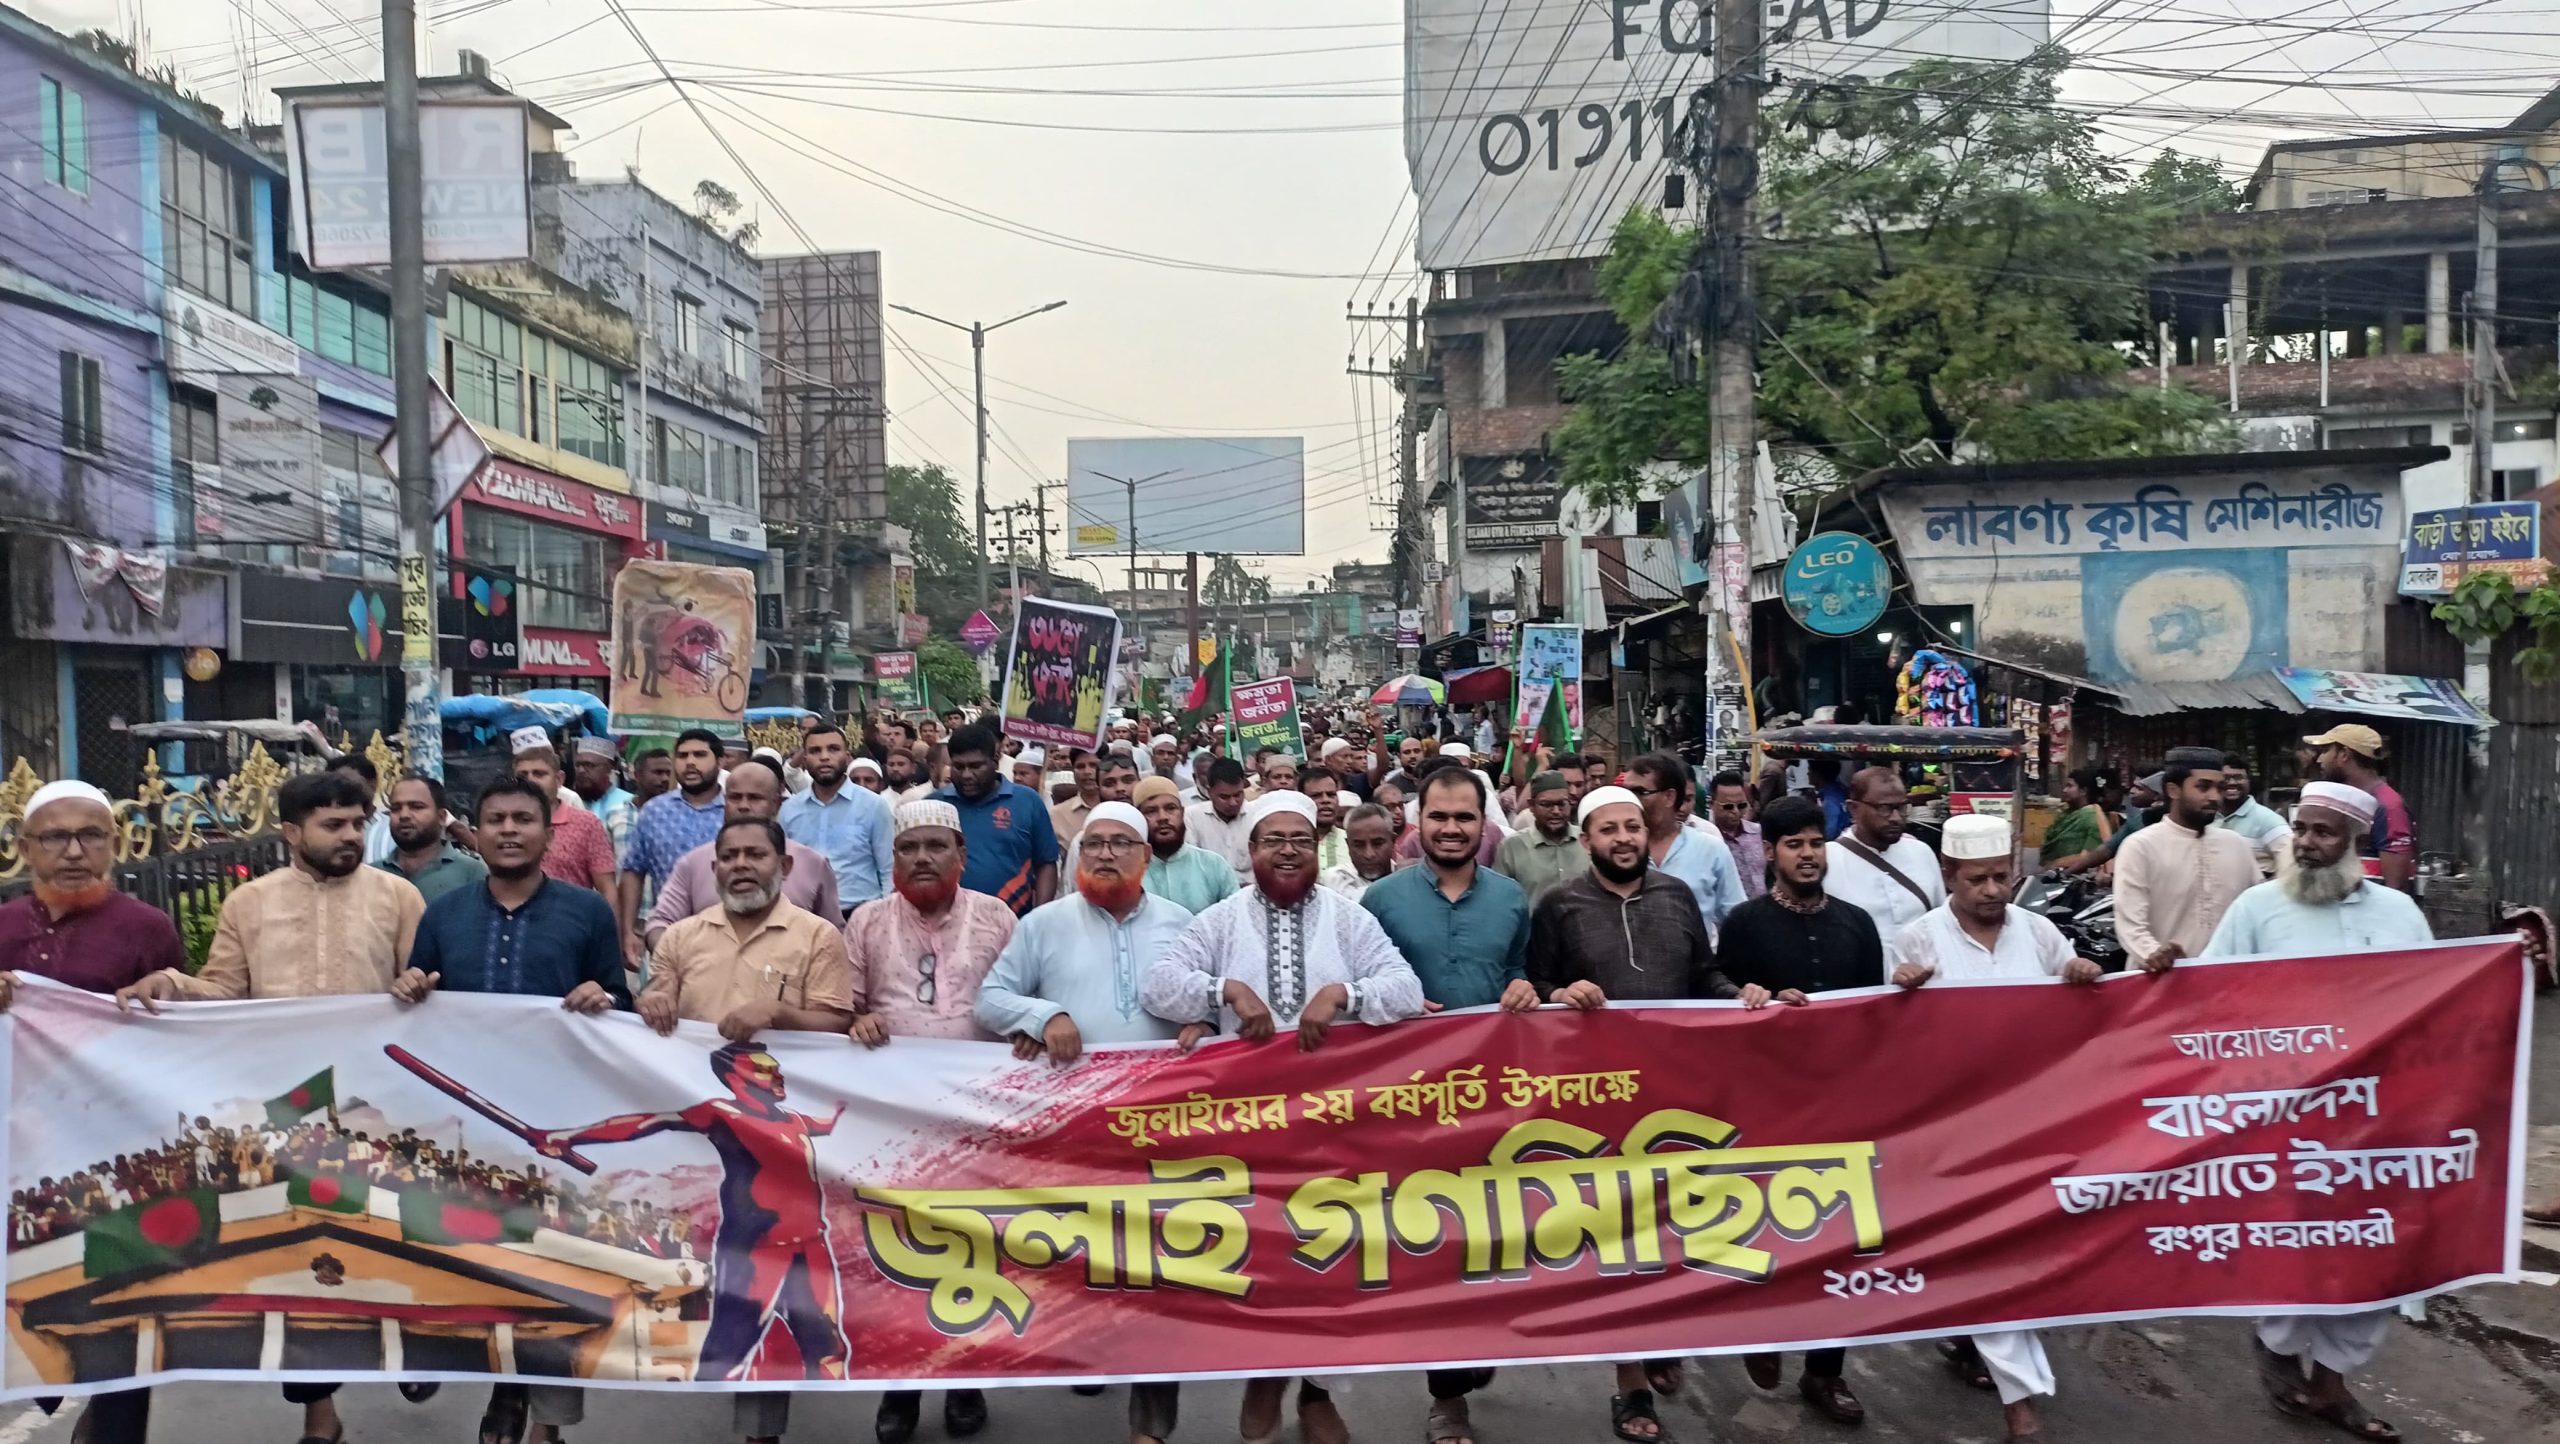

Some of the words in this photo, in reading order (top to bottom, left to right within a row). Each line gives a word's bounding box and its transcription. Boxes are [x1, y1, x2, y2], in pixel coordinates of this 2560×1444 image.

[665, 511, 693, 529] SONY
[1921, 498, 2073, 546] লাবণ্য
[2084, 484, 2193, 550] কৃষি
[2204, 481, 2384, 532] মেশিনারীজ
[2490, 509, 2531, 543] হইবে
[403, 557, 425, 593] পুর
[1805, 550, 1855, 568] LEO
[493, 642, 516, 656] LG
[522, 637, 573, 665] MUNA
[1235, 683, 1282, 700] ক্ষমতা
[1240, 700, 1287, 718] জনতা
[2171, 1024, 2350, 1060] আয়োজনে:
[1106, 1092, 1288, 1148] জুলাইয়ের
[1302, 1088, 1356, 1125] ২য়
[1369, 1064, 1487, 1128] বর্ষপূর্তি
[1500, 1065, 1642, 1109] উপলক্ষে
[2142, 1075, 2380, 1137] বাংলাদেশ
[2051, 1152, 2278, 1215] জামায়াতে
[2288, 1128, 2479, 1196] ইসলামী
[855, 1154, 1255, 1337] জুলাই
[1282, 1108, 1885, 1292] গণমিছিল
[2146, 1222, 2241, 1262] রংপুর
[2246, 1207, 2396, 1248] মহানগরী
[1822, 1266, 1926, 1299] ২০২৬
